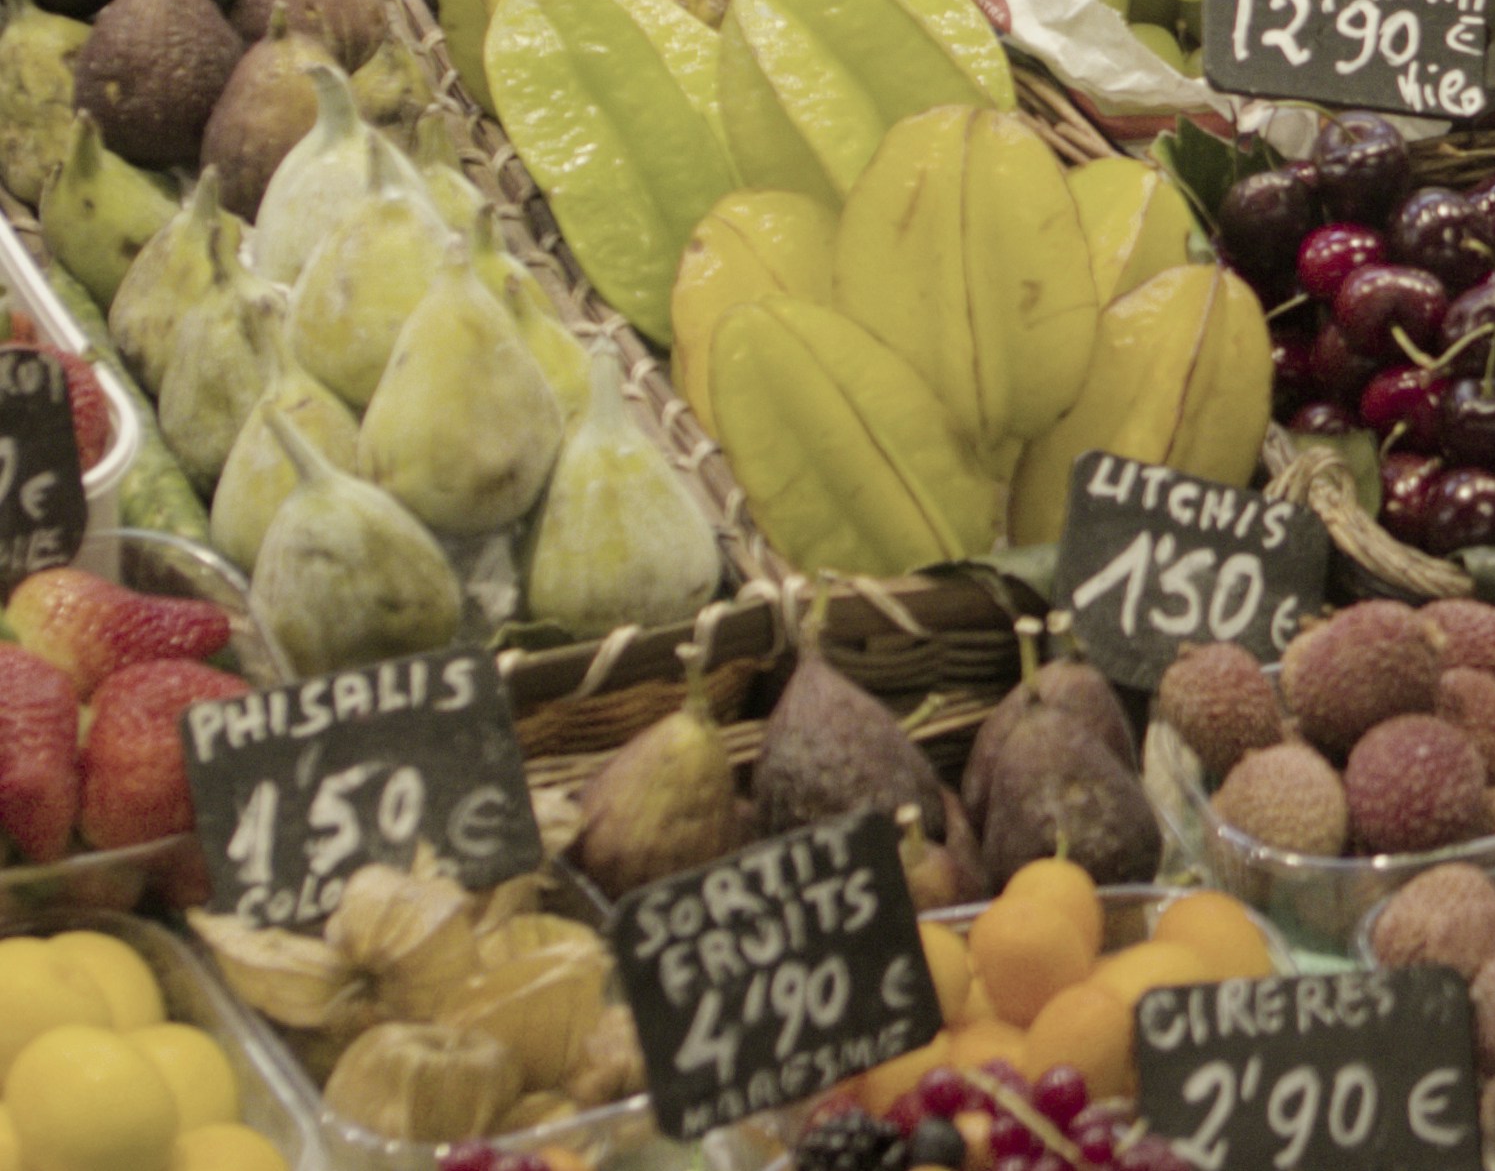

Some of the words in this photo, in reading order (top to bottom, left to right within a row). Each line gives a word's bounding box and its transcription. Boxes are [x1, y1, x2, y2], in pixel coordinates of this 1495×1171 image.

[1072, 530, 1264, 642] 1'50
[187, 657, 476, 763] PHISALIS
[634, 827, 850, 960] SORTIT
[658, 866, 879, 1008] FRUITS
[672, 954, 850, 1086] 4'90
[1140, 975, 1396, 1052] CIRERES
[1170, 1053, 1380, 1171] 2'90
